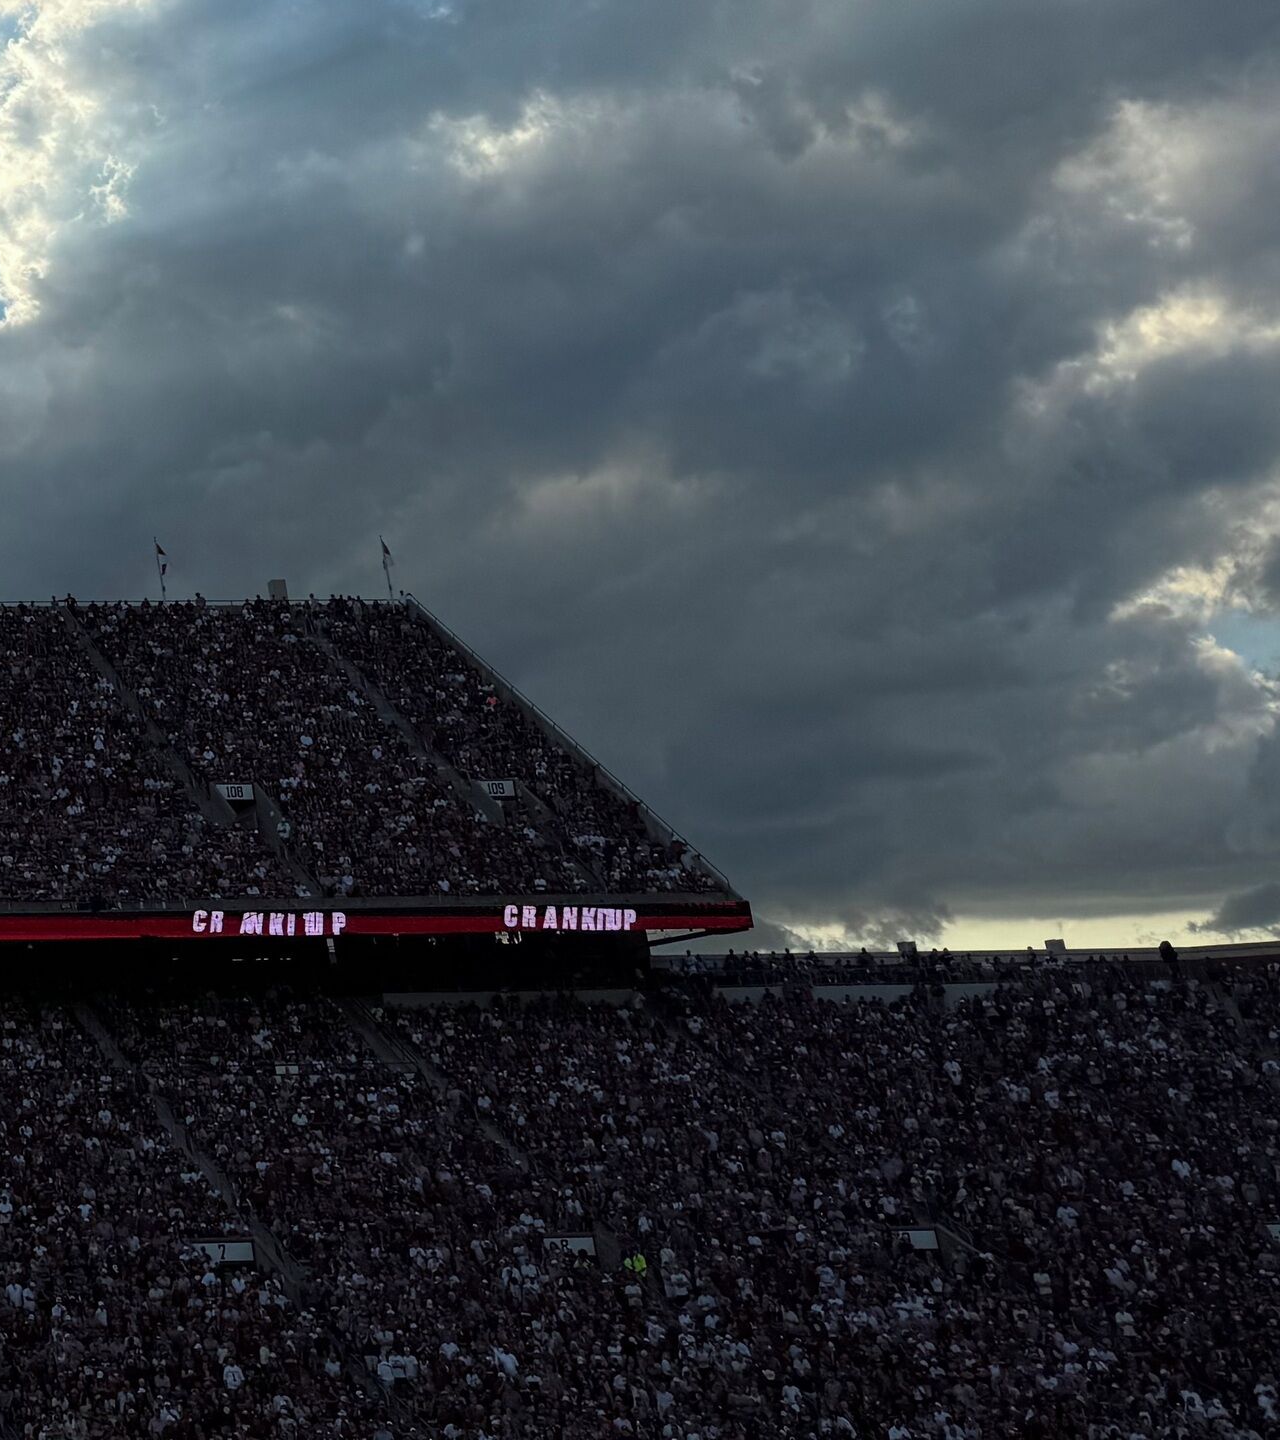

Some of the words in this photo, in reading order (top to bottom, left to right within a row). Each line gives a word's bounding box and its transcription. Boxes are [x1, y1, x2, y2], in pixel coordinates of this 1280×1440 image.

[226, 786, 243, 798] 108
[487, 783, 505, 794] 109
[218, 1244, 226, 1259] 7
